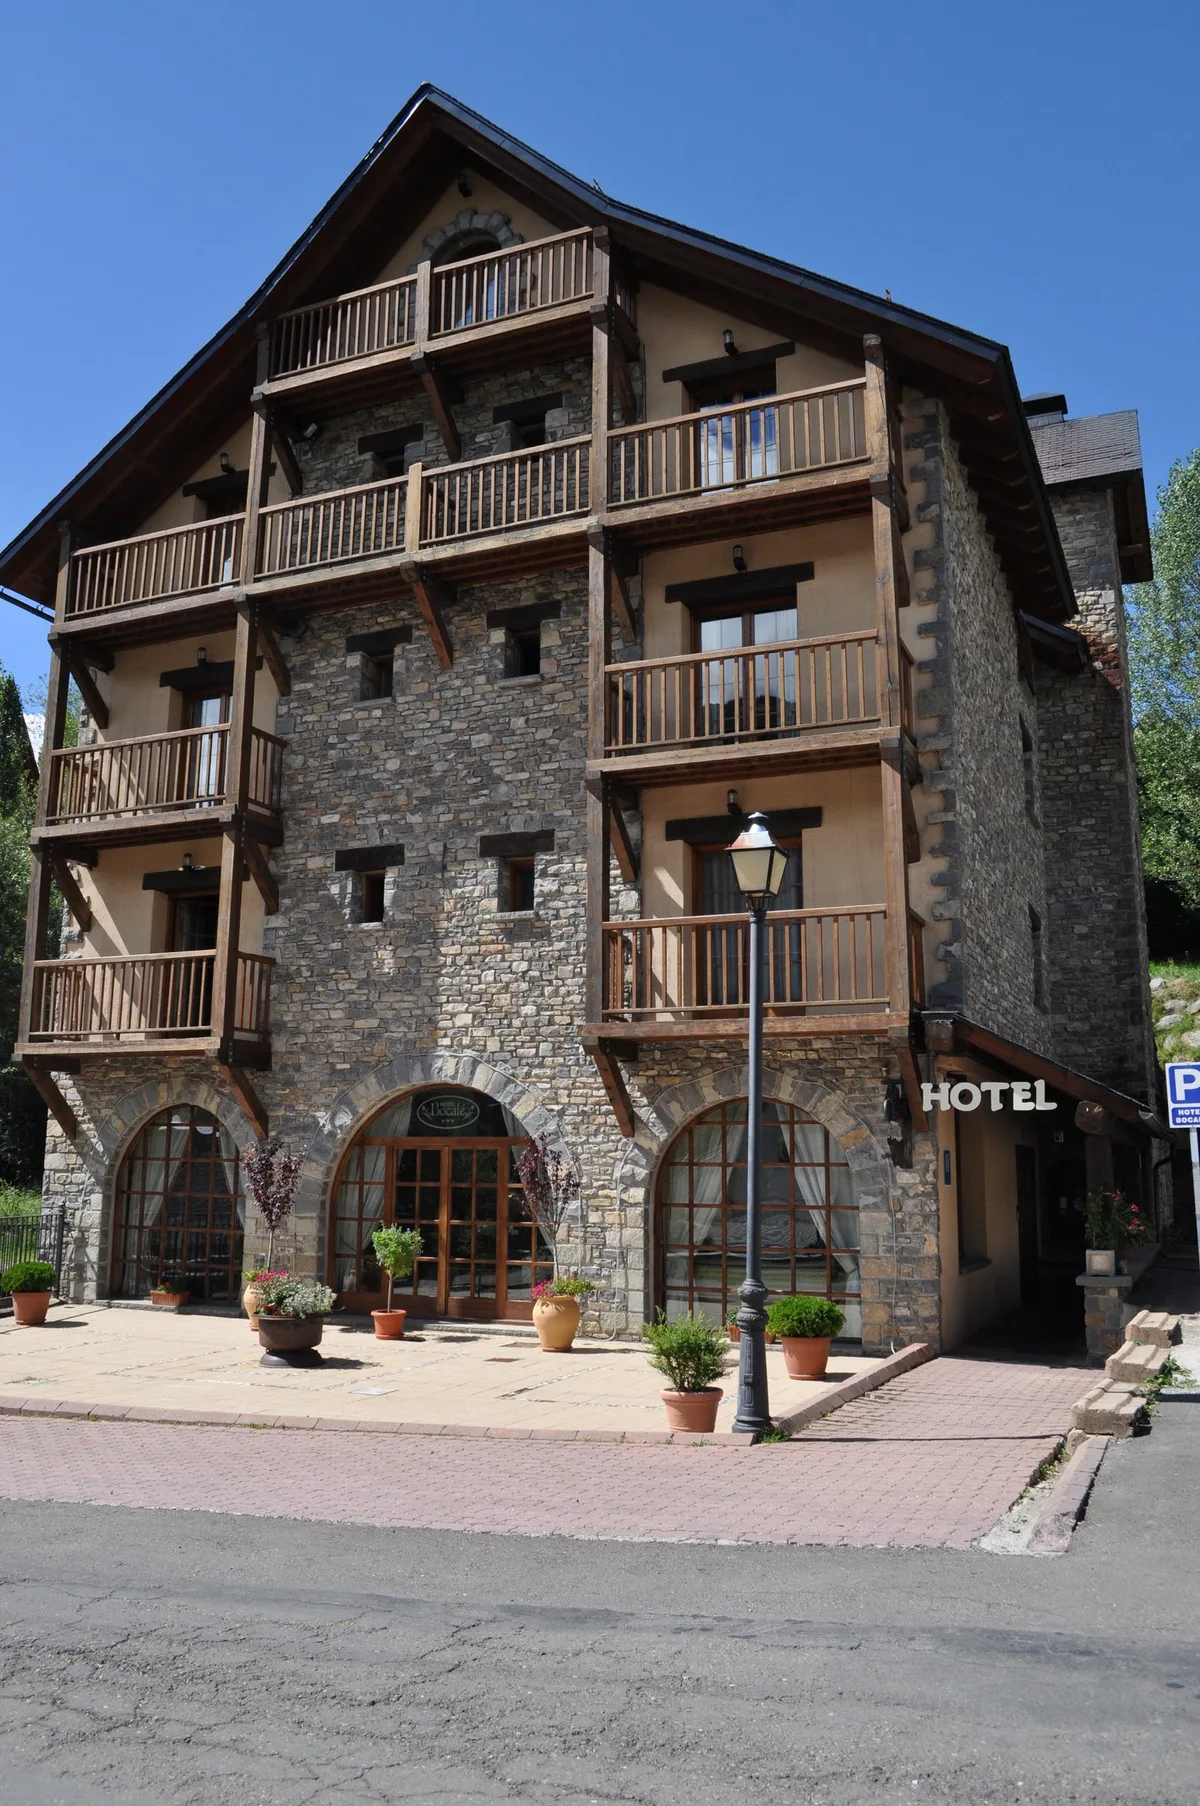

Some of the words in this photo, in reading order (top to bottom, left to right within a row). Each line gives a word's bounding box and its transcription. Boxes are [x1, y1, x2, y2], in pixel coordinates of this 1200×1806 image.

[920, 1079, 1058, 1112] HOTEL
[1174, 1068, 1200, 1101] P
[431, 1102, 465, 1117] Bocalé
